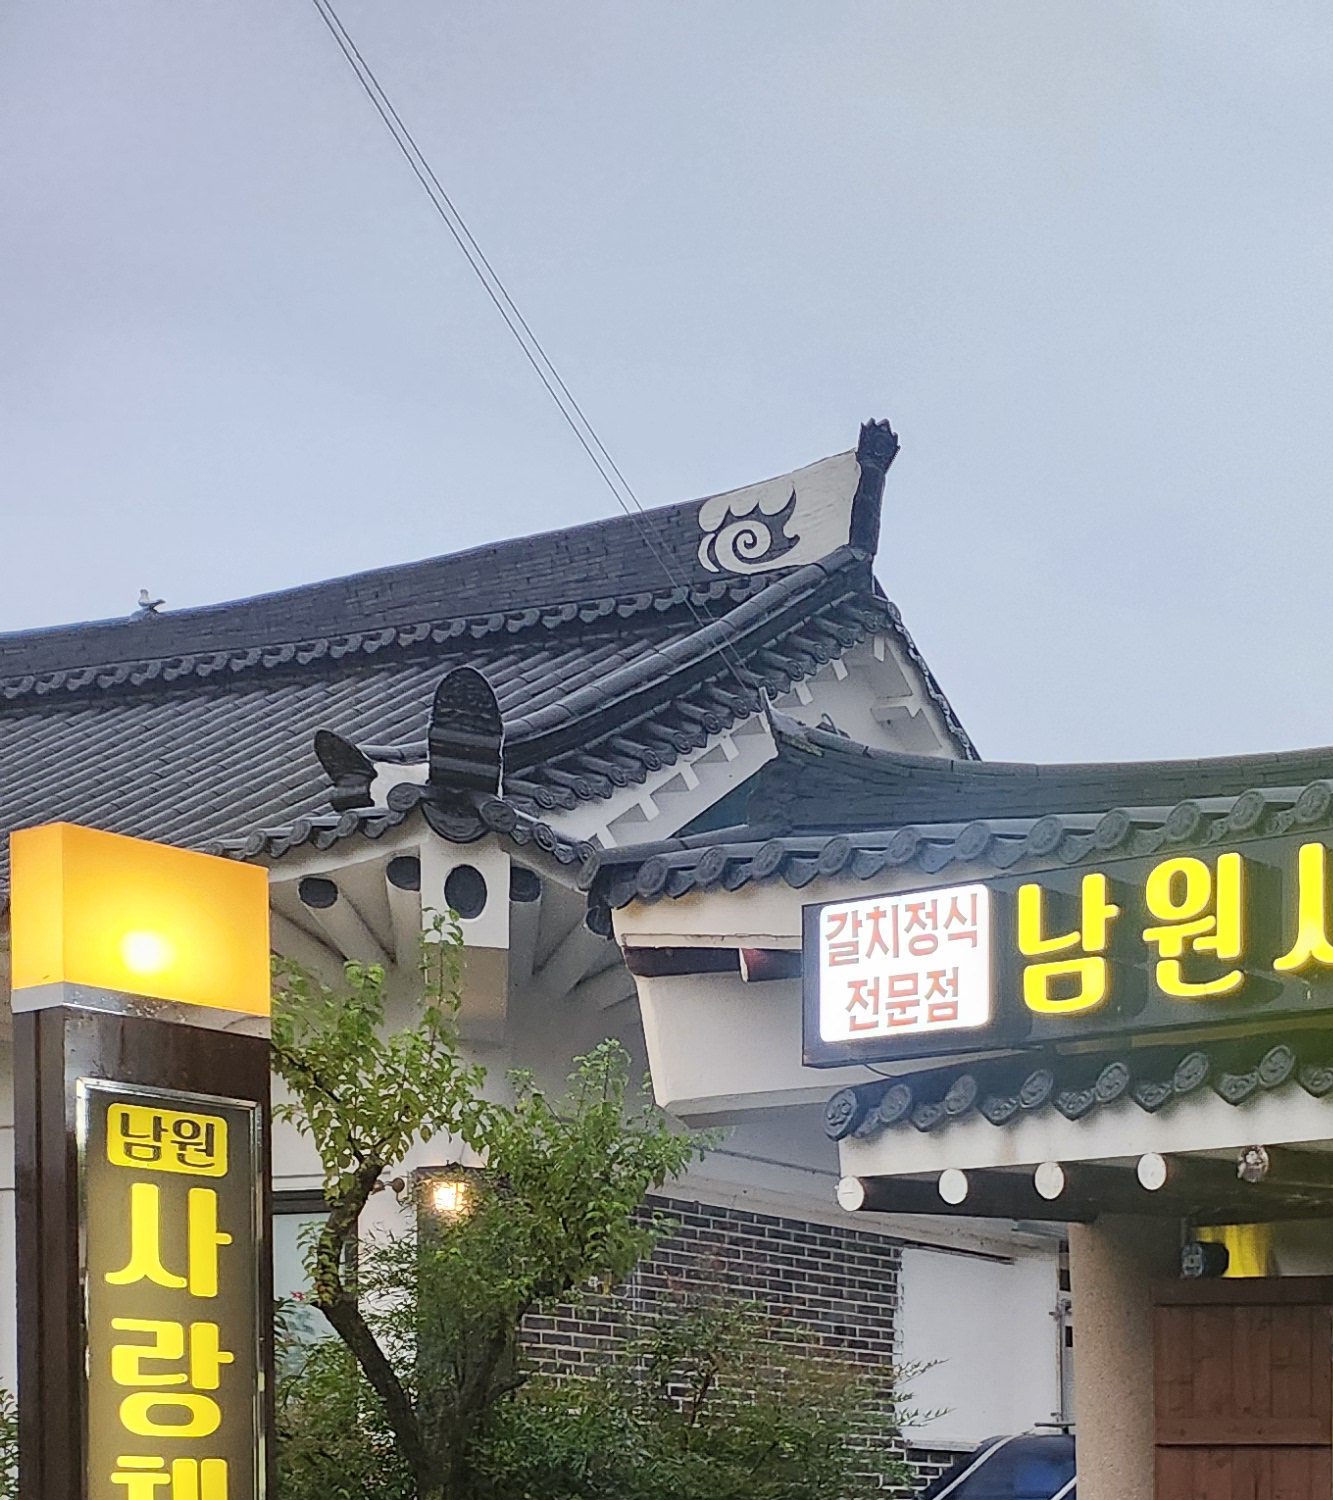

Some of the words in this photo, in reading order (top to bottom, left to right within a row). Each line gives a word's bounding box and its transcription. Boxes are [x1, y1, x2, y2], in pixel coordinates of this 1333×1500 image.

[825, 893, 977, 967] 갈치정식
[845, 967, 959, 1032] 전문점
[119, 1110, 217, 1167] 남원
